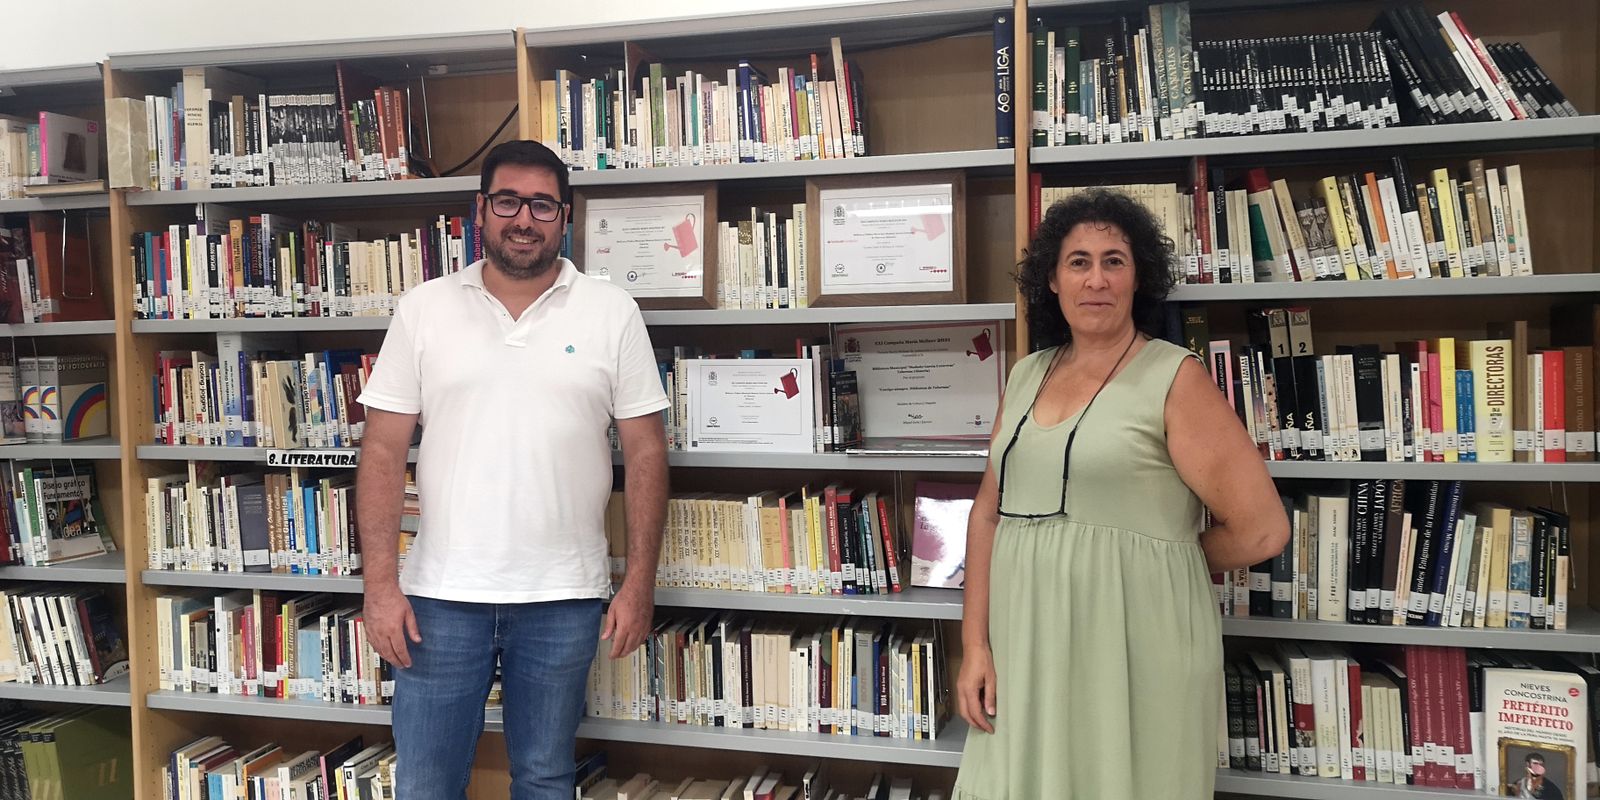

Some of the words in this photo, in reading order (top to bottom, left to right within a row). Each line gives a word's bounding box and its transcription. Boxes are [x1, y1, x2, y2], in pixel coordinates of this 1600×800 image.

[997, 47, 1010, 76] LIGA
[1105, 38, 1115, 66] España
[1166, 46, 1180, 99] CANARIAS
[1182, 53, 1192, 94] GALICIA
[998, 93, 1011, 113] 60
[1277, 344, 1285, 355] 1
[1298, 342, 1307, 353] 2
[199, 363, 207, 386] footing
[1485, 346, 1505, 406] DIRECTORAS
[1573, 353, 1583, 393] diamante
[1575, 396, 1583, 407] un
[1305, 411, 1317, 456] EÑA
[268, 453, 279, 466] 8.
[281, 453, 357, 466] LITERATURA
[1357, 482, 1369, 516] CHINA
[1373, 479, 1386, 511] JAPÓN
[281, 496, 290, 533] Gramatical
[1424, 520, 1433, 528] la
[1422, 528, 1432, 538] de
[1443, 533, 1453, 554] MUNDO
[1419, 539, 1431, 570] Enigmas
[1504, 689, 1568, 704] CONCOSTRINA
[1520, 682, 1551, 695] NIEVES
[1503, 699, 1568, 717] PRETÉRITO
[1498, 712, 1574, 731] IMPERFECTO
